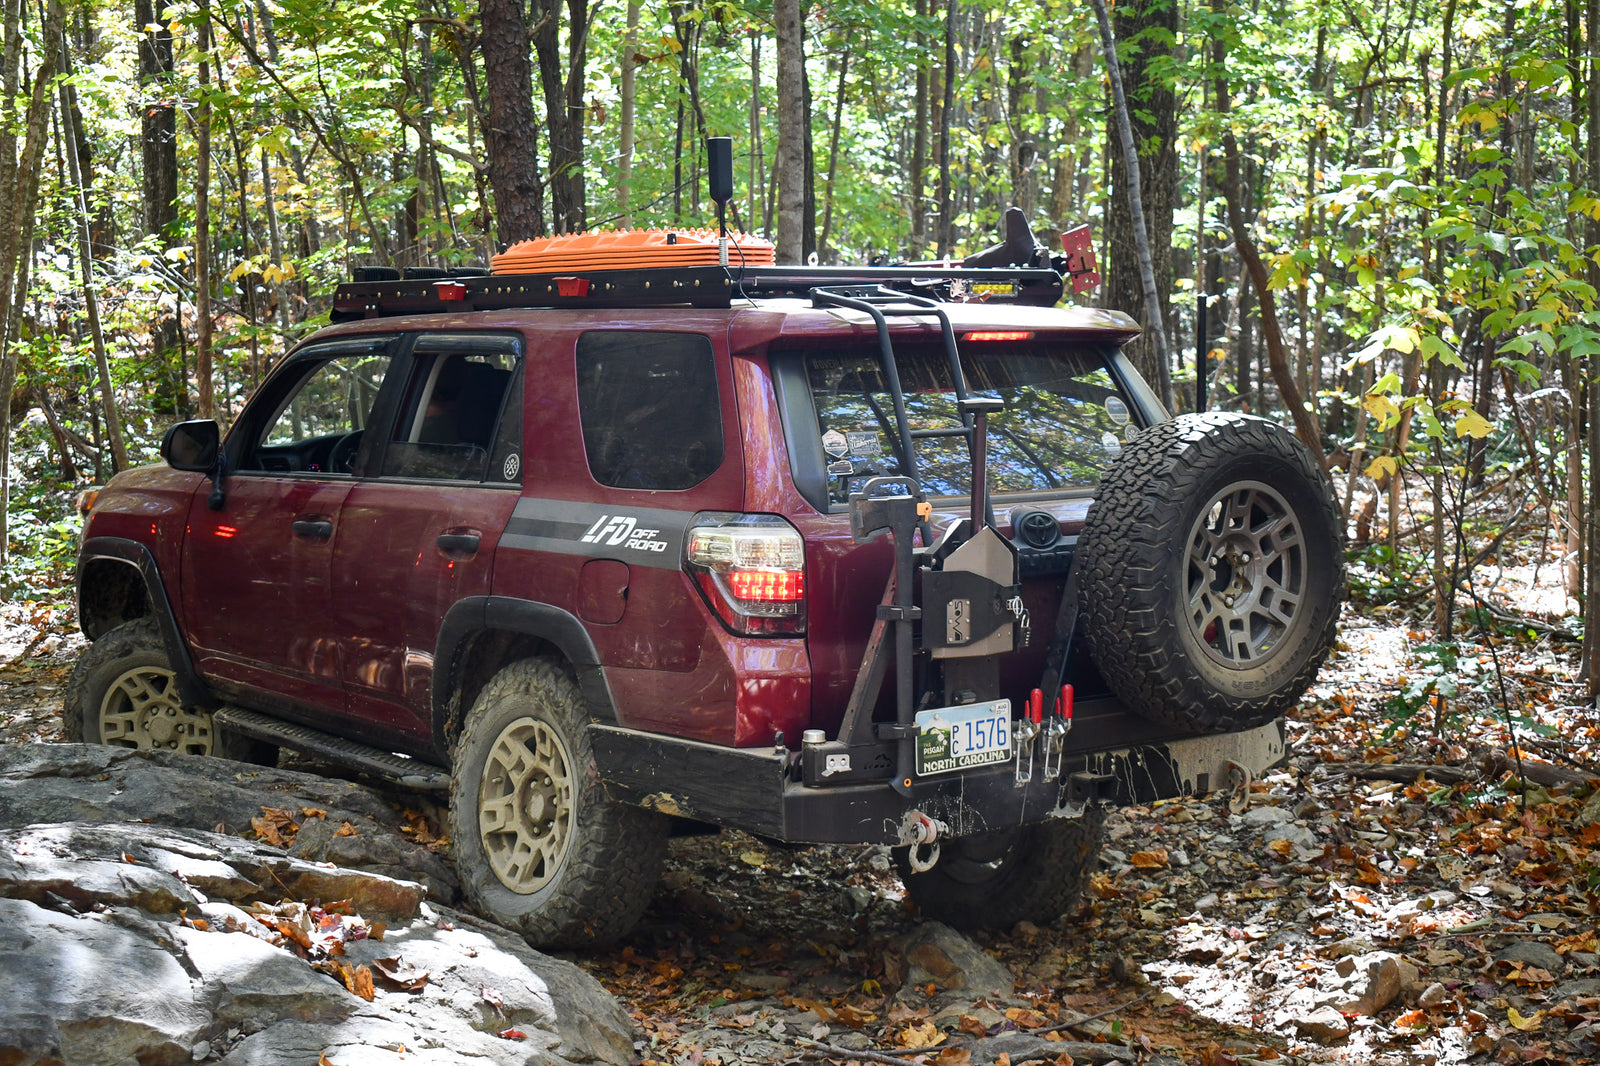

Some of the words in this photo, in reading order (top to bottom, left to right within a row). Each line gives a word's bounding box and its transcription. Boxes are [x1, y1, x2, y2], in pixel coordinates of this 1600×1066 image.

[581, 515, 637, 546] LFD
[630, 528, 660, 540] OFF
[624, 538, 668, 552] ROAD
[965, 716, 1007, 752] 1576
[923, 746, 945, 755] PISGAH
[923, 758, 956, 772] NORTH
[959, 751, 1005, 765] CAROLINA
